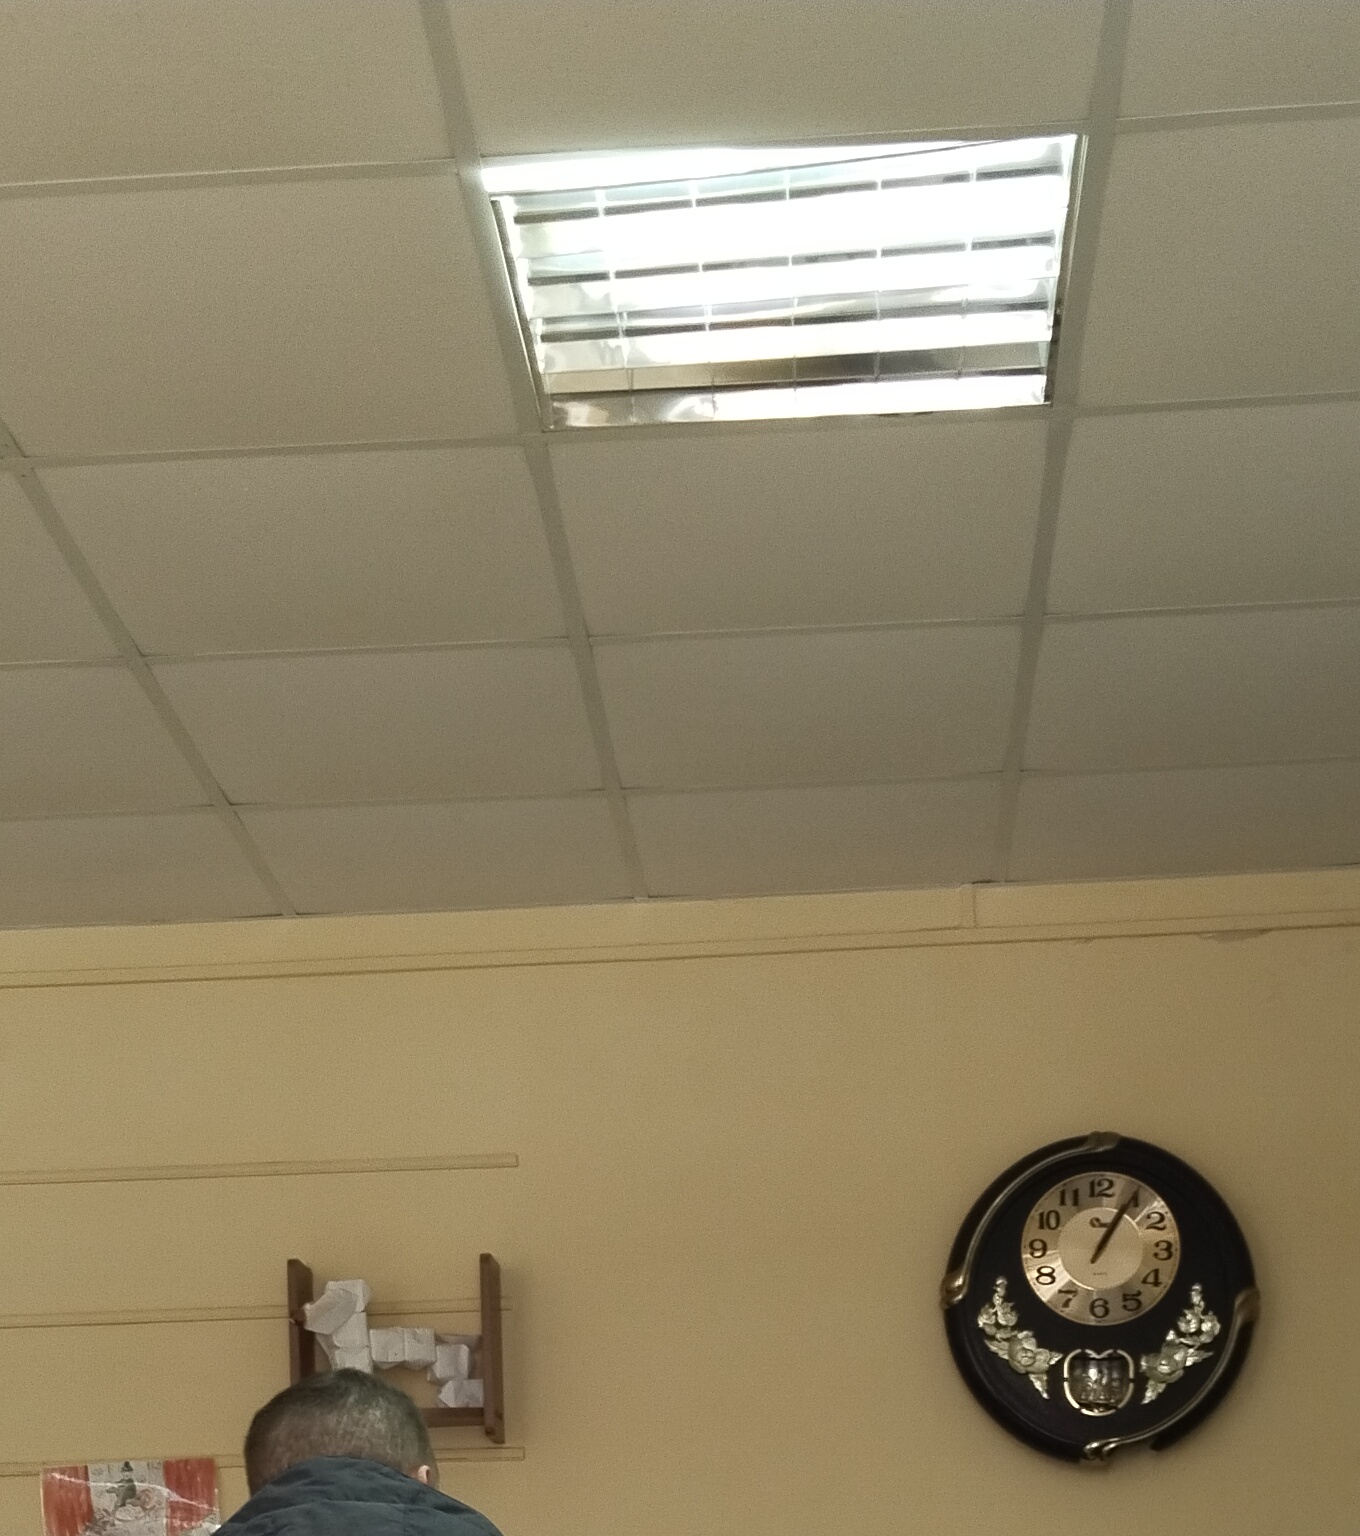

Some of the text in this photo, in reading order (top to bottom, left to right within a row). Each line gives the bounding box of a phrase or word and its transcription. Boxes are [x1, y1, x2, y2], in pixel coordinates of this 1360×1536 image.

[1059, 1188, 1079, 1207] 11
[1089, 1178, 1115, 1198] 12
[1038, 1210, 1060, 1230] 10
[1145, 1211, 1167, 1231] 2
[1028, 1239, 1048, 1258] 9
[1153, 1240, 1173, 1261] 3
[1035, 1265, 1056, 1285] 8
[1141, 1268, 1162, 1287] 4
[1057, 1288, 1078, 1308] 7
[1090, 1298, 1109, 1318] 6
[1122, 1290, 1142, 1311] 5
